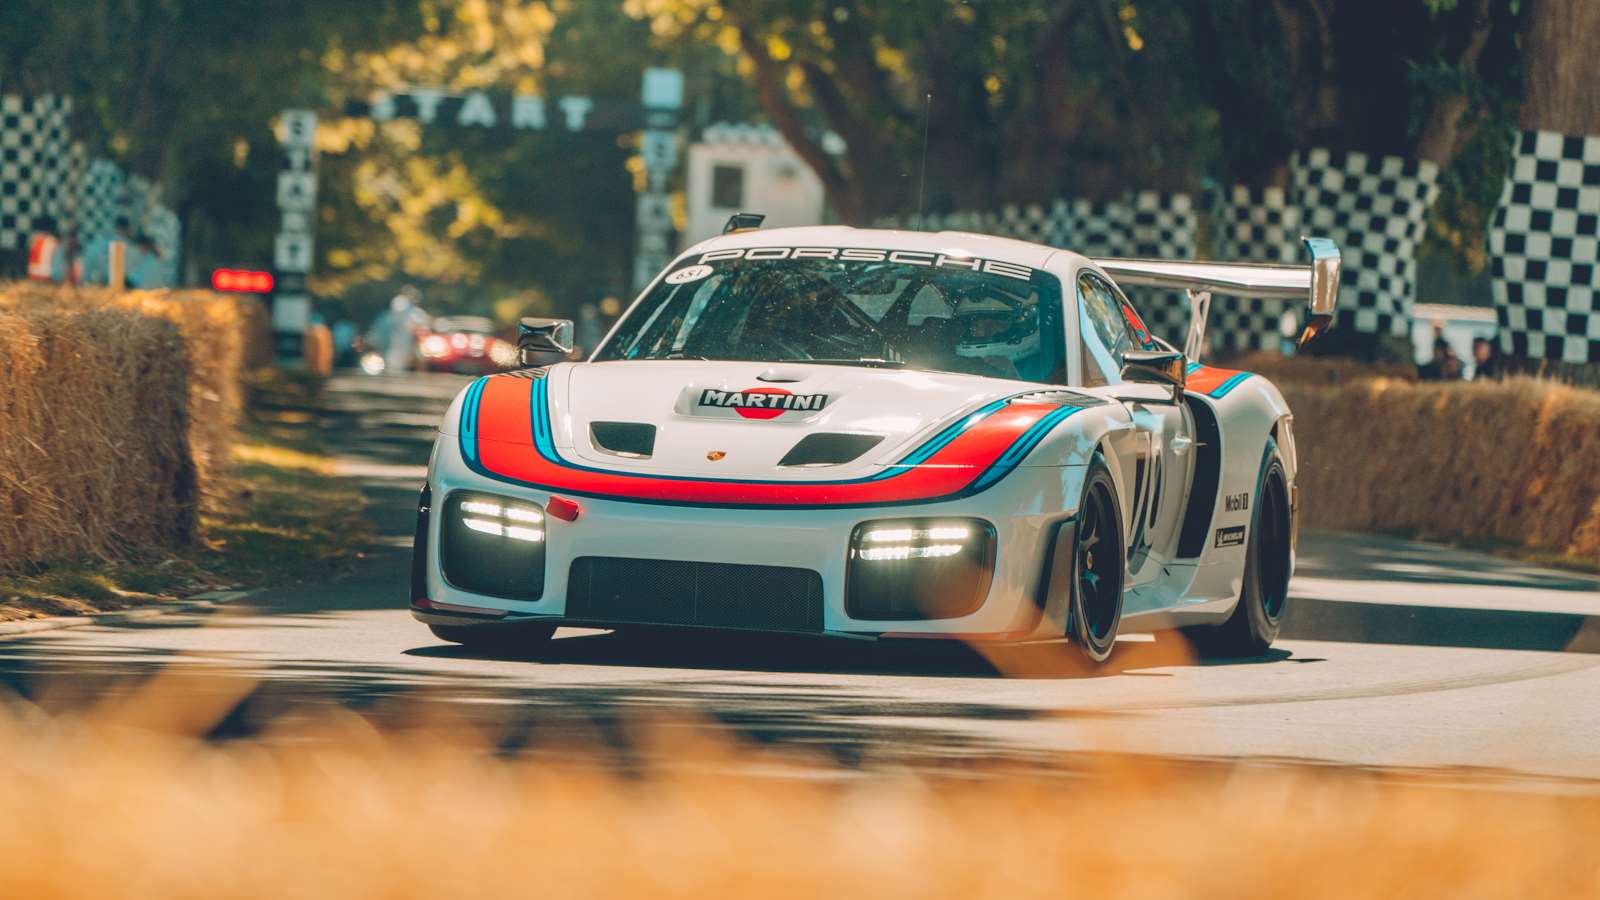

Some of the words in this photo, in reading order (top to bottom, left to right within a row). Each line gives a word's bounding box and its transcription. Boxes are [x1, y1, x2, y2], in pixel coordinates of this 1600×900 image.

[371, 91, 592, 130] START
[278, 111, 316, 271] START
[698, 247, 1033, 281] PORSCHE
[704, 390, 823, 410] MARTINI
